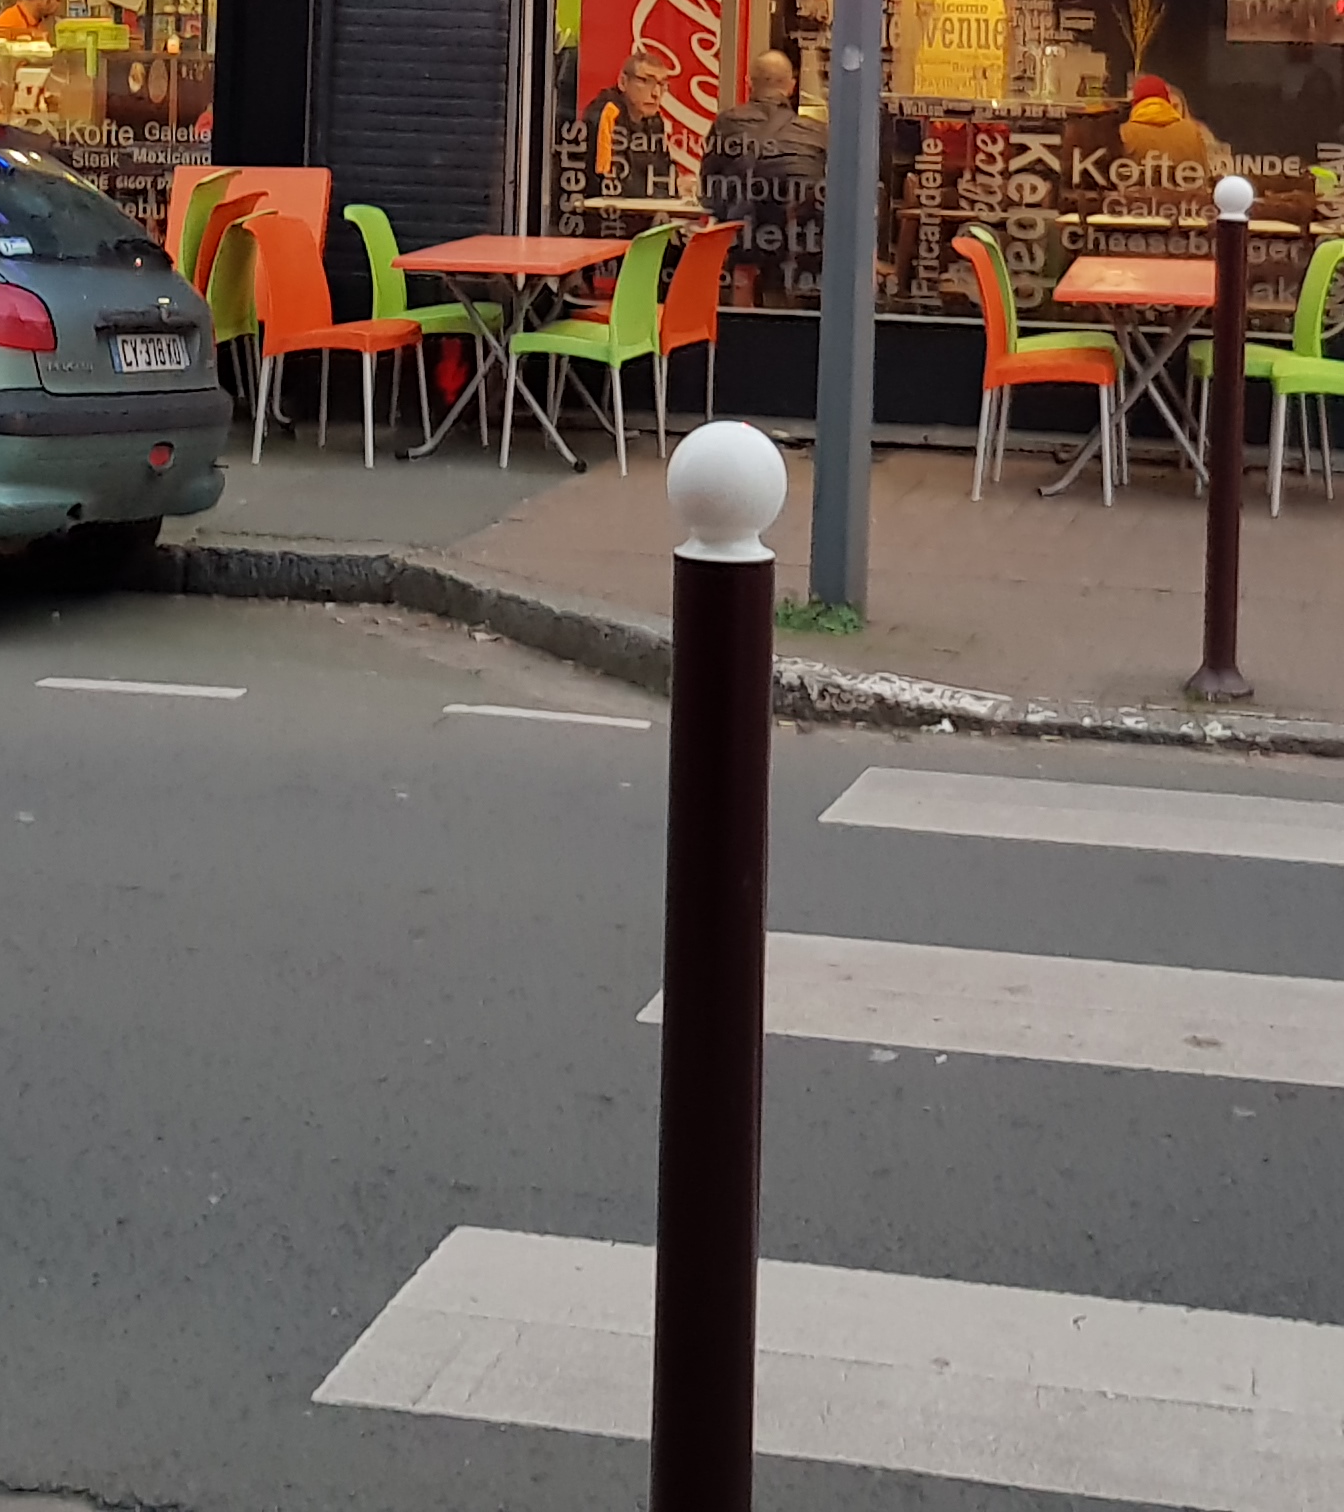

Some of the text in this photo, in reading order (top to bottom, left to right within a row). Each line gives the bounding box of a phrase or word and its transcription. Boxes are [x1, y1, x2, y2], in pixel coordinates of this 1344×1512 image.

[66, 119, 134, 146] Kofte
[556, 119, 588, 237] sserts
[645, 162, 828, 213] Hmburg
[957, 132, 1006, 240] élice
[1072, 146, 1205, 190] Kofte
[1007, 133, 1061, 308] Kebab
[1061, 224, 1306, 264] Cheesebger
